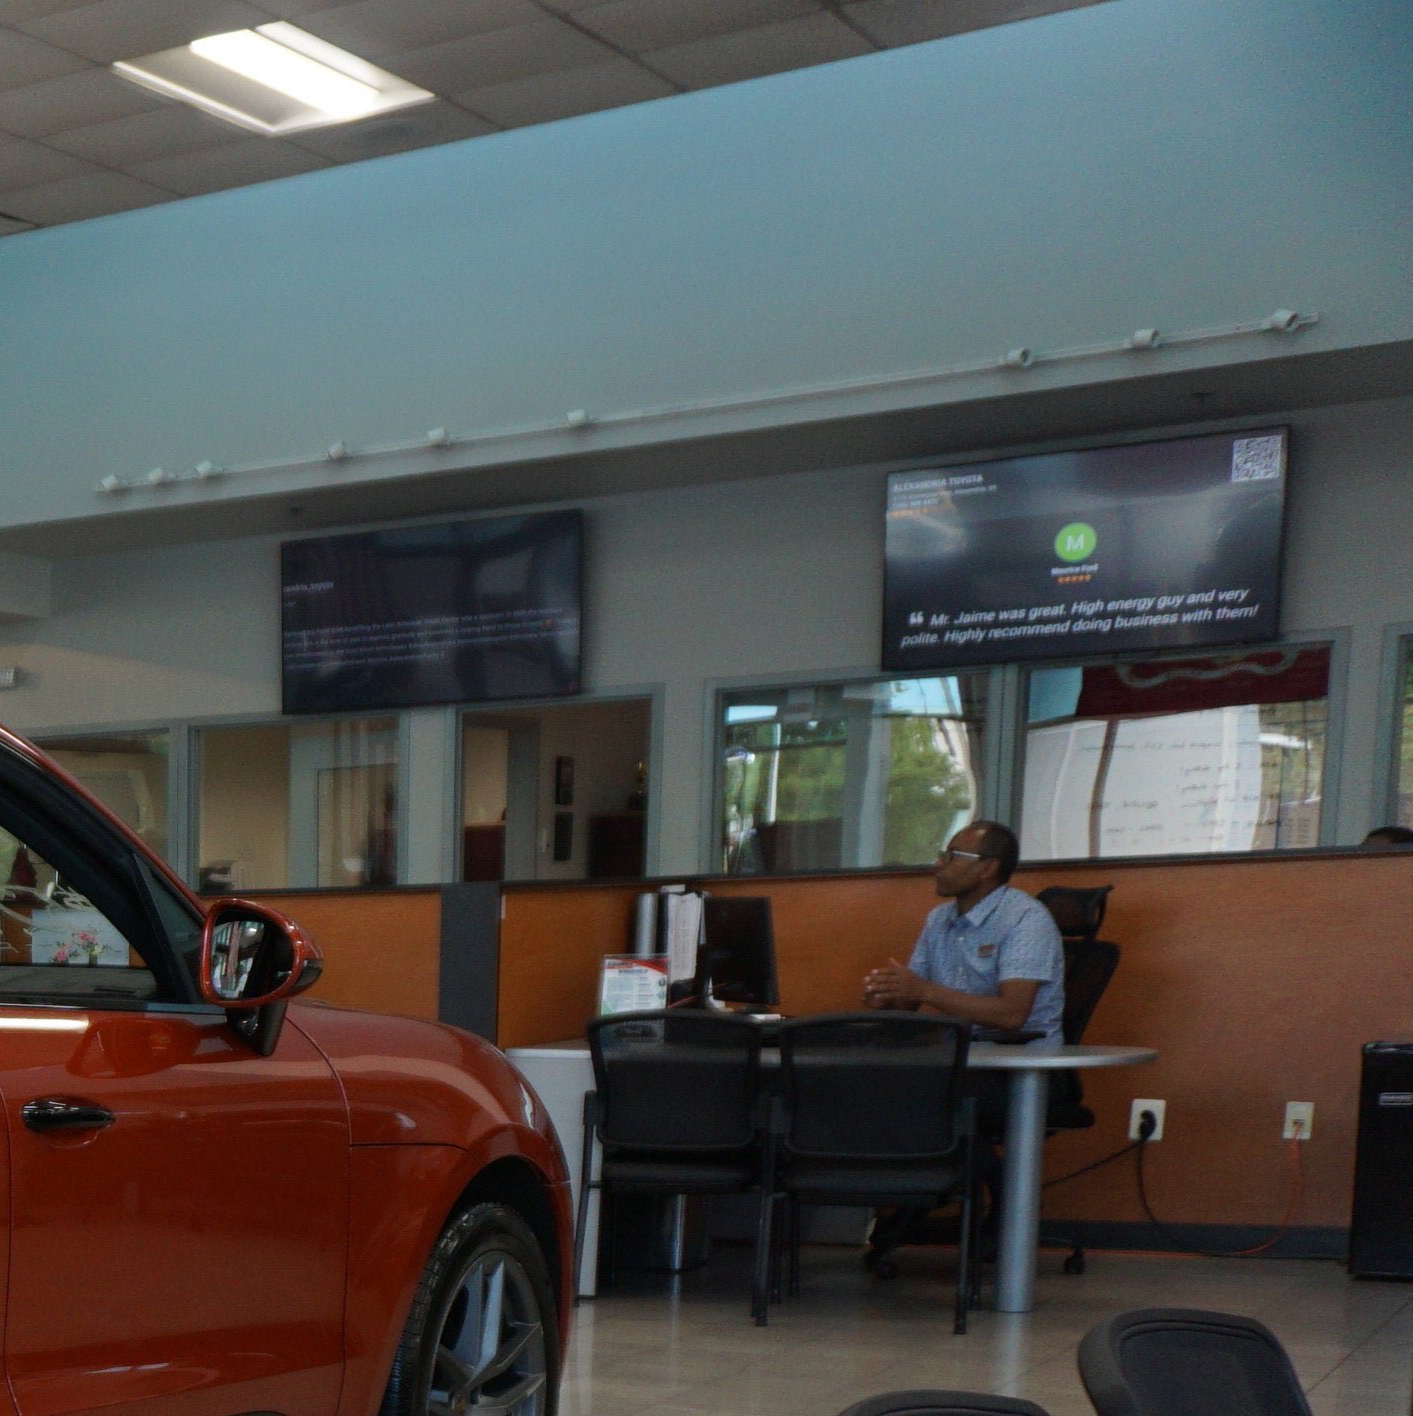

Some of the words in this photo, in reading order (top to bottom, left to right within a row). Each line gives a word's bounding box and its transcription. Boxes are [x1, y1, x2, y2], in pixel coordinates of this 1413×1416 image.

[1066, 533, 1084, 551] M
[900, 632, 940, 649] polite.
[943, 629, 986, 644] Highly
[987, 619, 1071, 639] recommend
[1072, 617, 1112, 632] doing
[1114, 612, 1178, 628] business
[1181, 609, 1213, 624] with
[1215, 603, 1260, 620] them!
[930, 613, 951, 627] Mr.
[953, 611, 996, 625] Jaime
[998, 608, 1026, 621] was
[1028, 603, 1067, 621] great.
[1071, 600, 1104, 616] High
[1107, 596, 1155, 611] energy
[1157, 594, 1185, 608] guy
[1187, 589, 1217, 604] and
[1218, 588, 1250, 602] very
